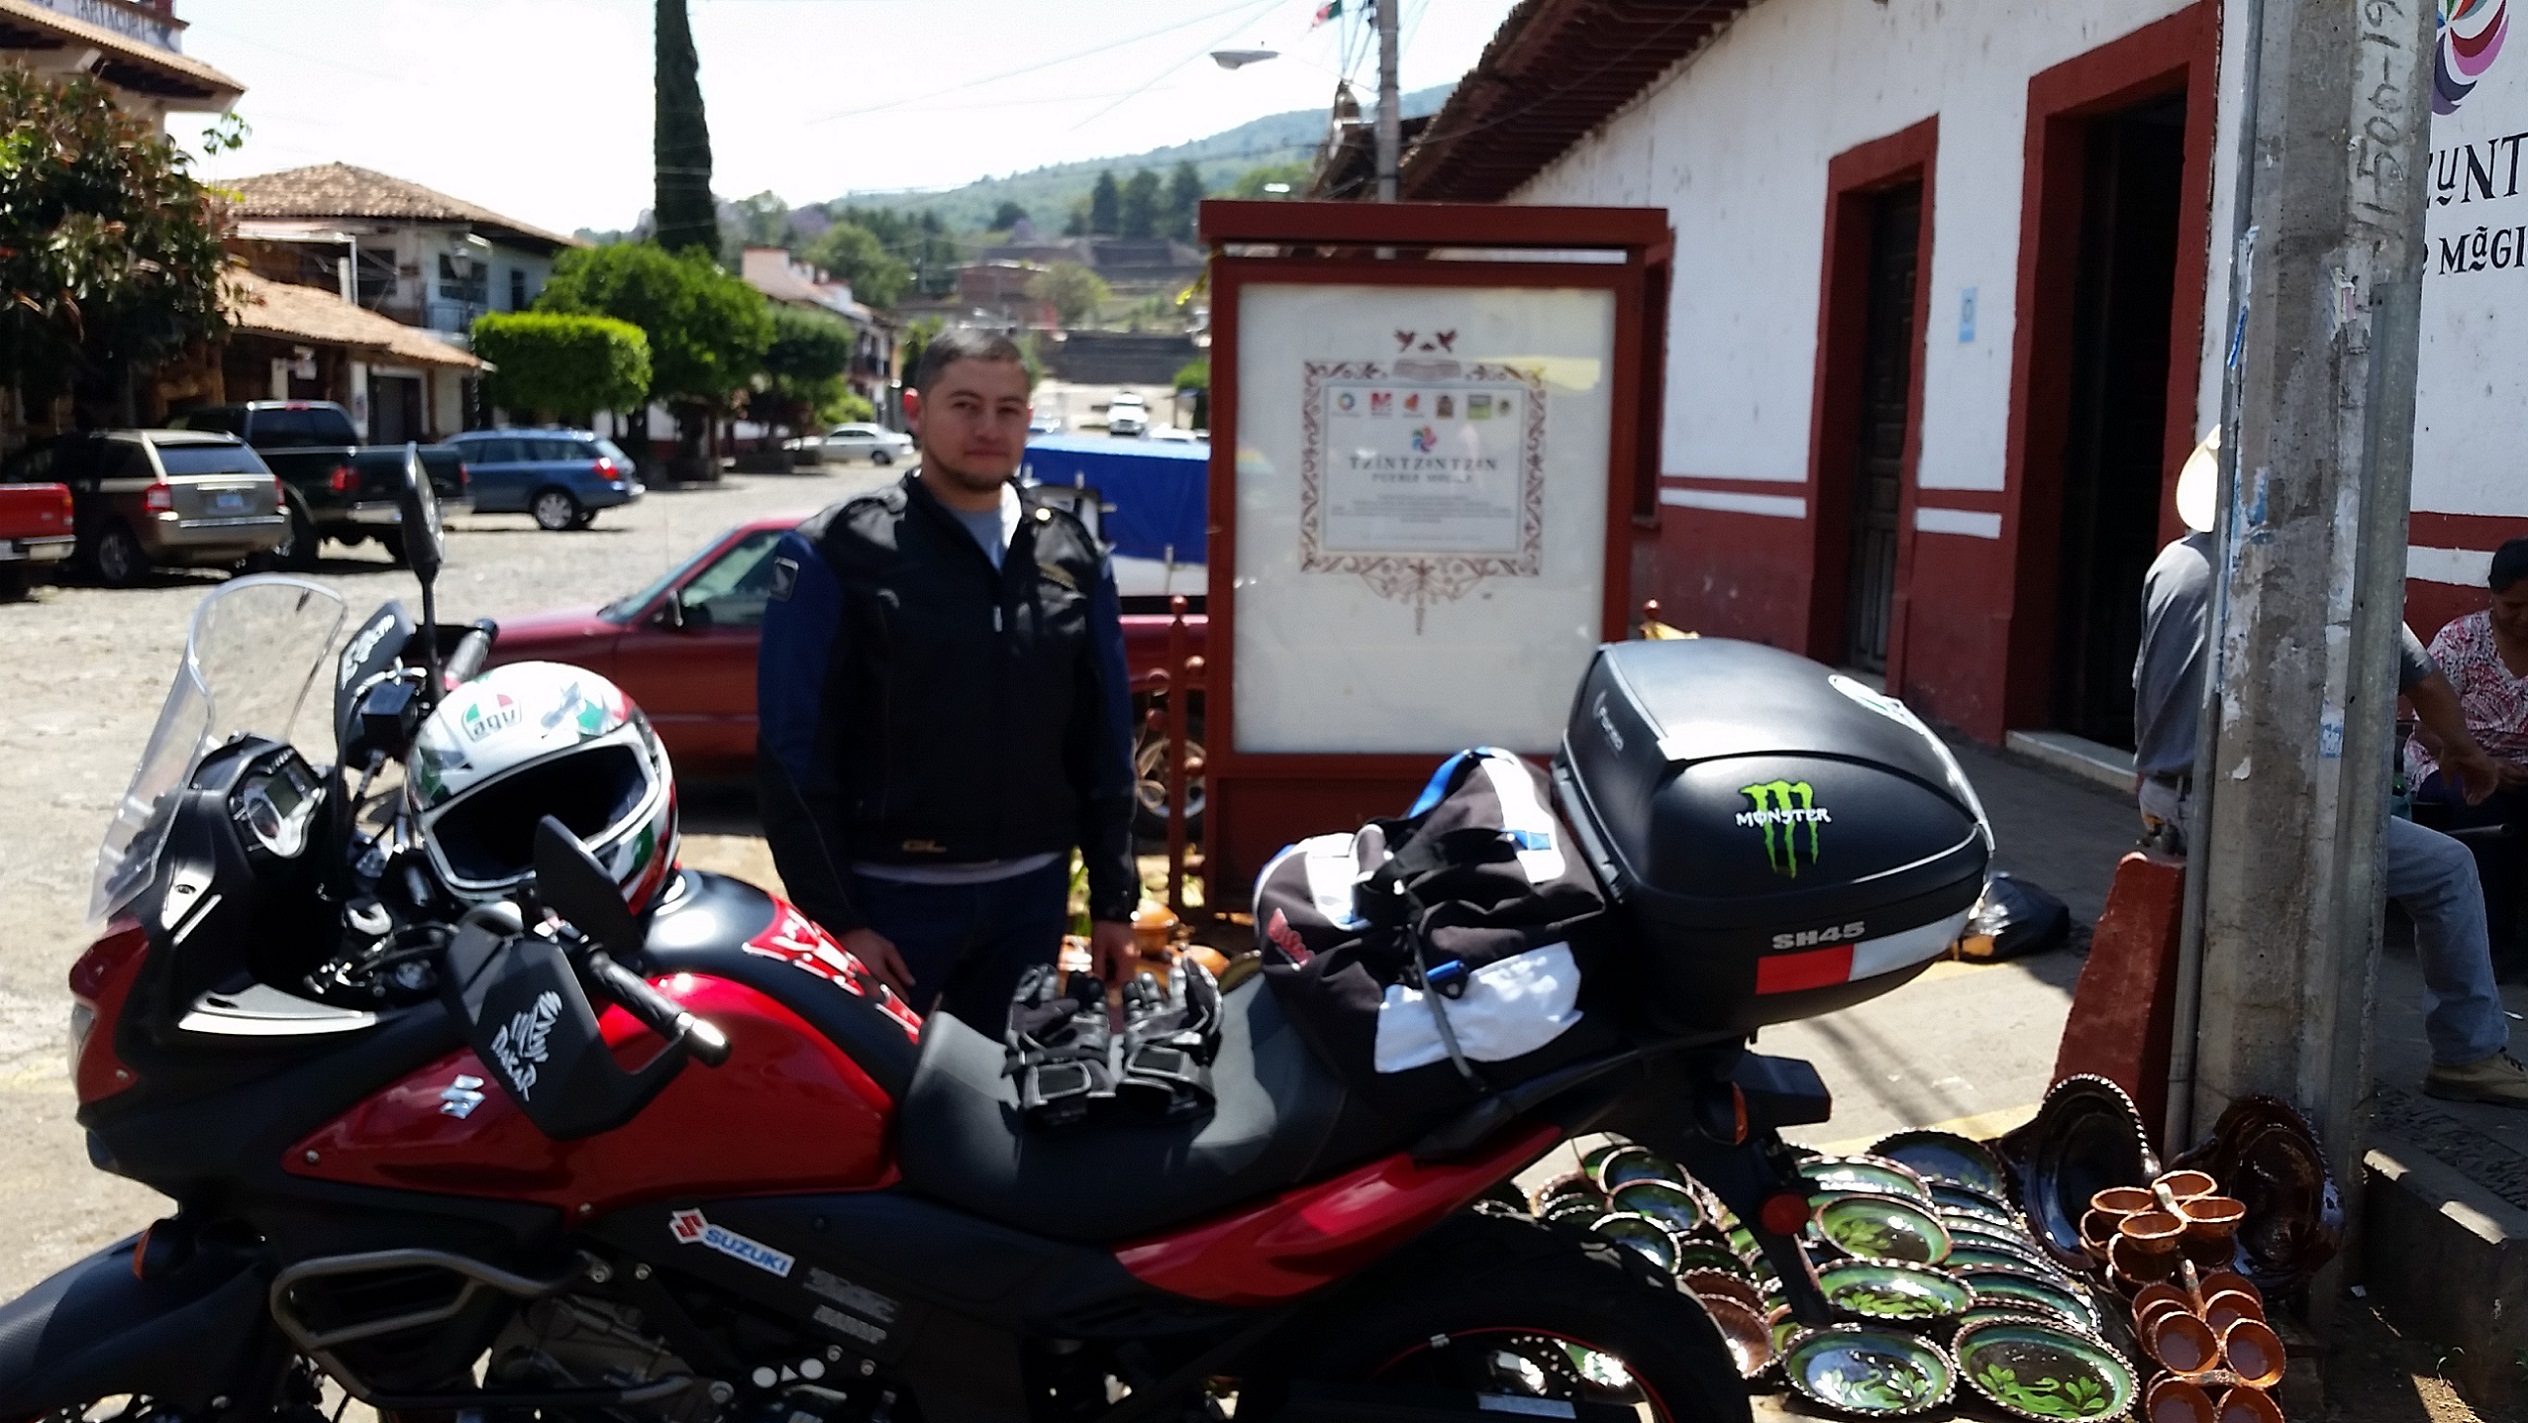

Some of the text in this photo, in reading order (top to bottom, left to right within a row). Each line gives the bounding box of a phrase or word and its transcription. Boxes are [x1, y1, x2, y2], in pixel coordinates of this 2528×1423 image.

[1735, 807, 1832, 828] MONSTER
[1772, 920, 1866, 950] SH45
[705, 1228, 789, 1273] SUZUKI
